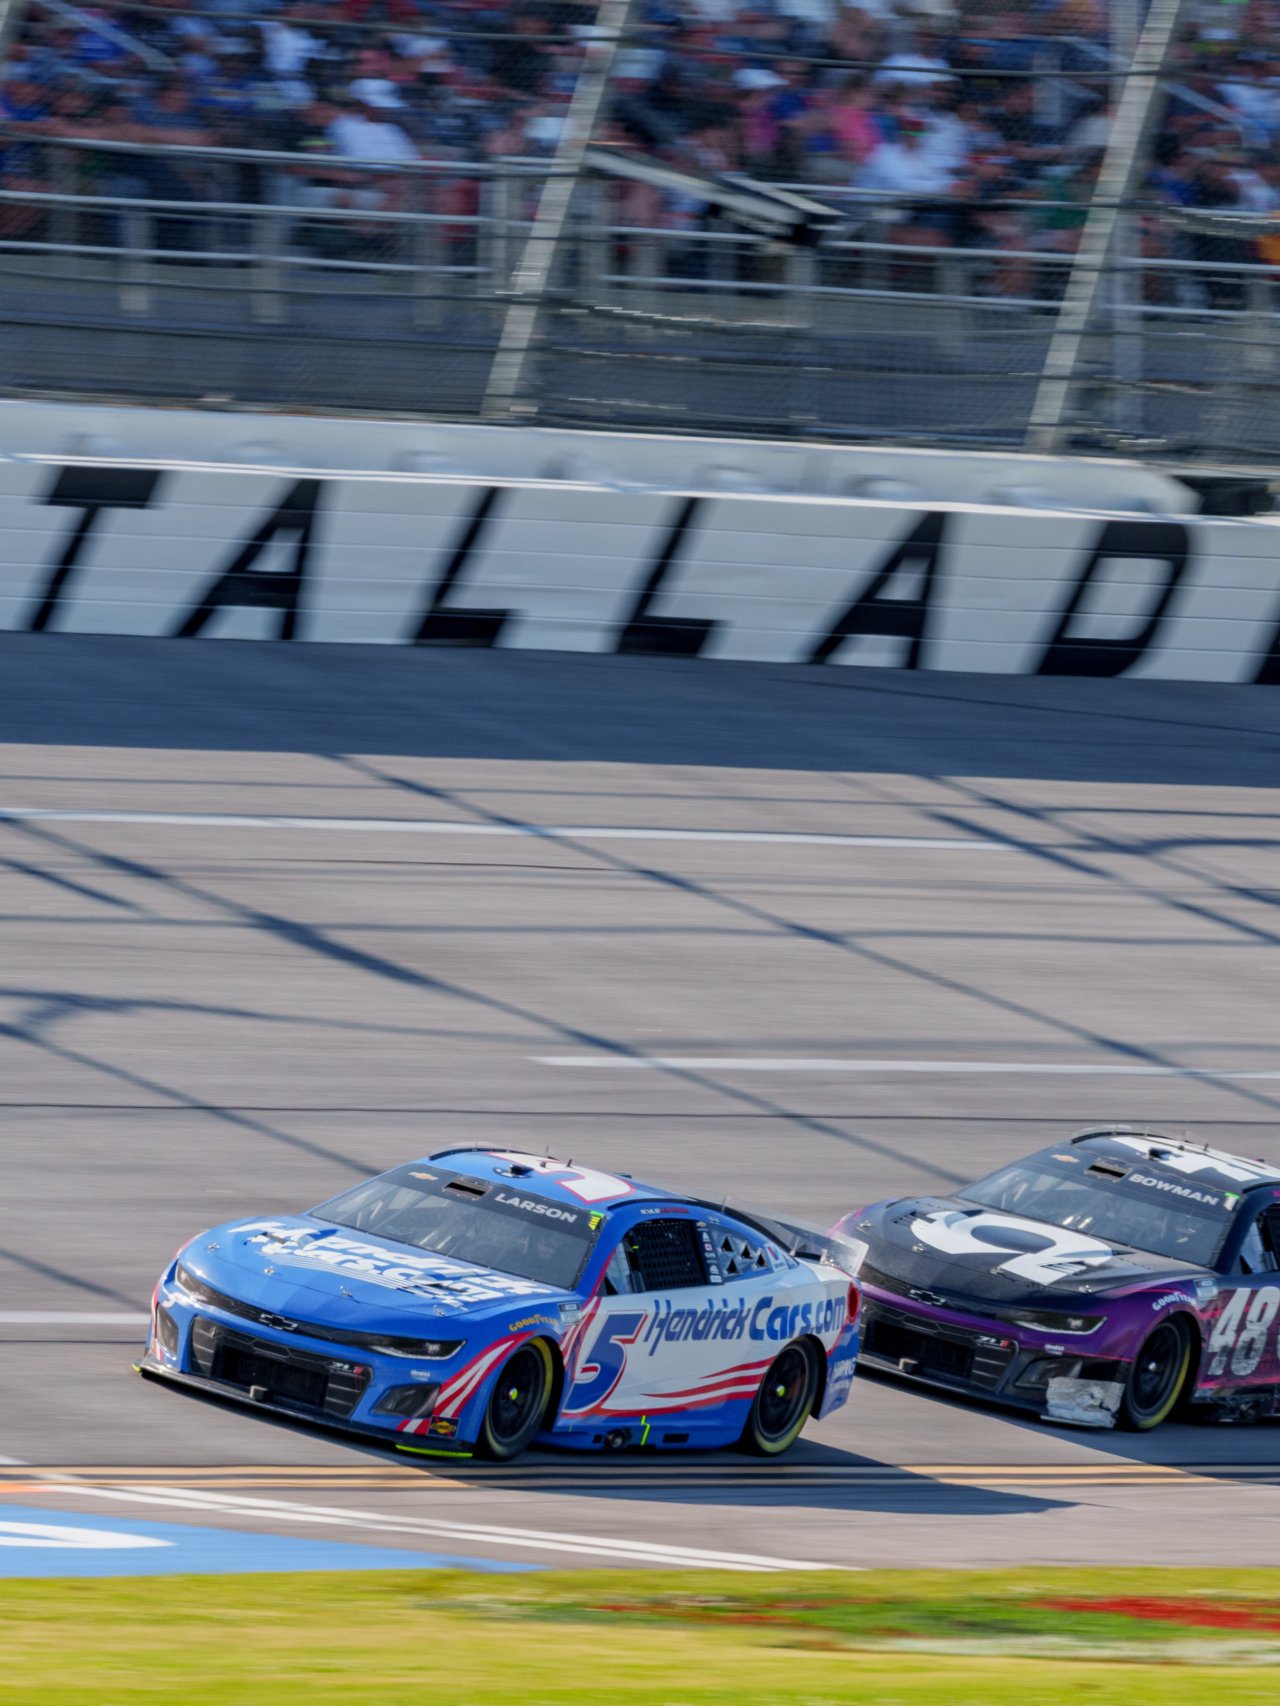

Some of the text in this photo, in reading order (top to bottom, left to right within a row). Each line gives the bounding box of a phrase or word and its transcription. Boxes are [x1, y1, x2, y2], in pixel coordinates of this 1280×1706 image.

[495, 1193, 578, 1223] LARSON
[1129, 1173, 1220, 1205] BOWMAN
[563, 1309, 649, 1414] 5
[1208, 1286, 1280, 1376] 48
